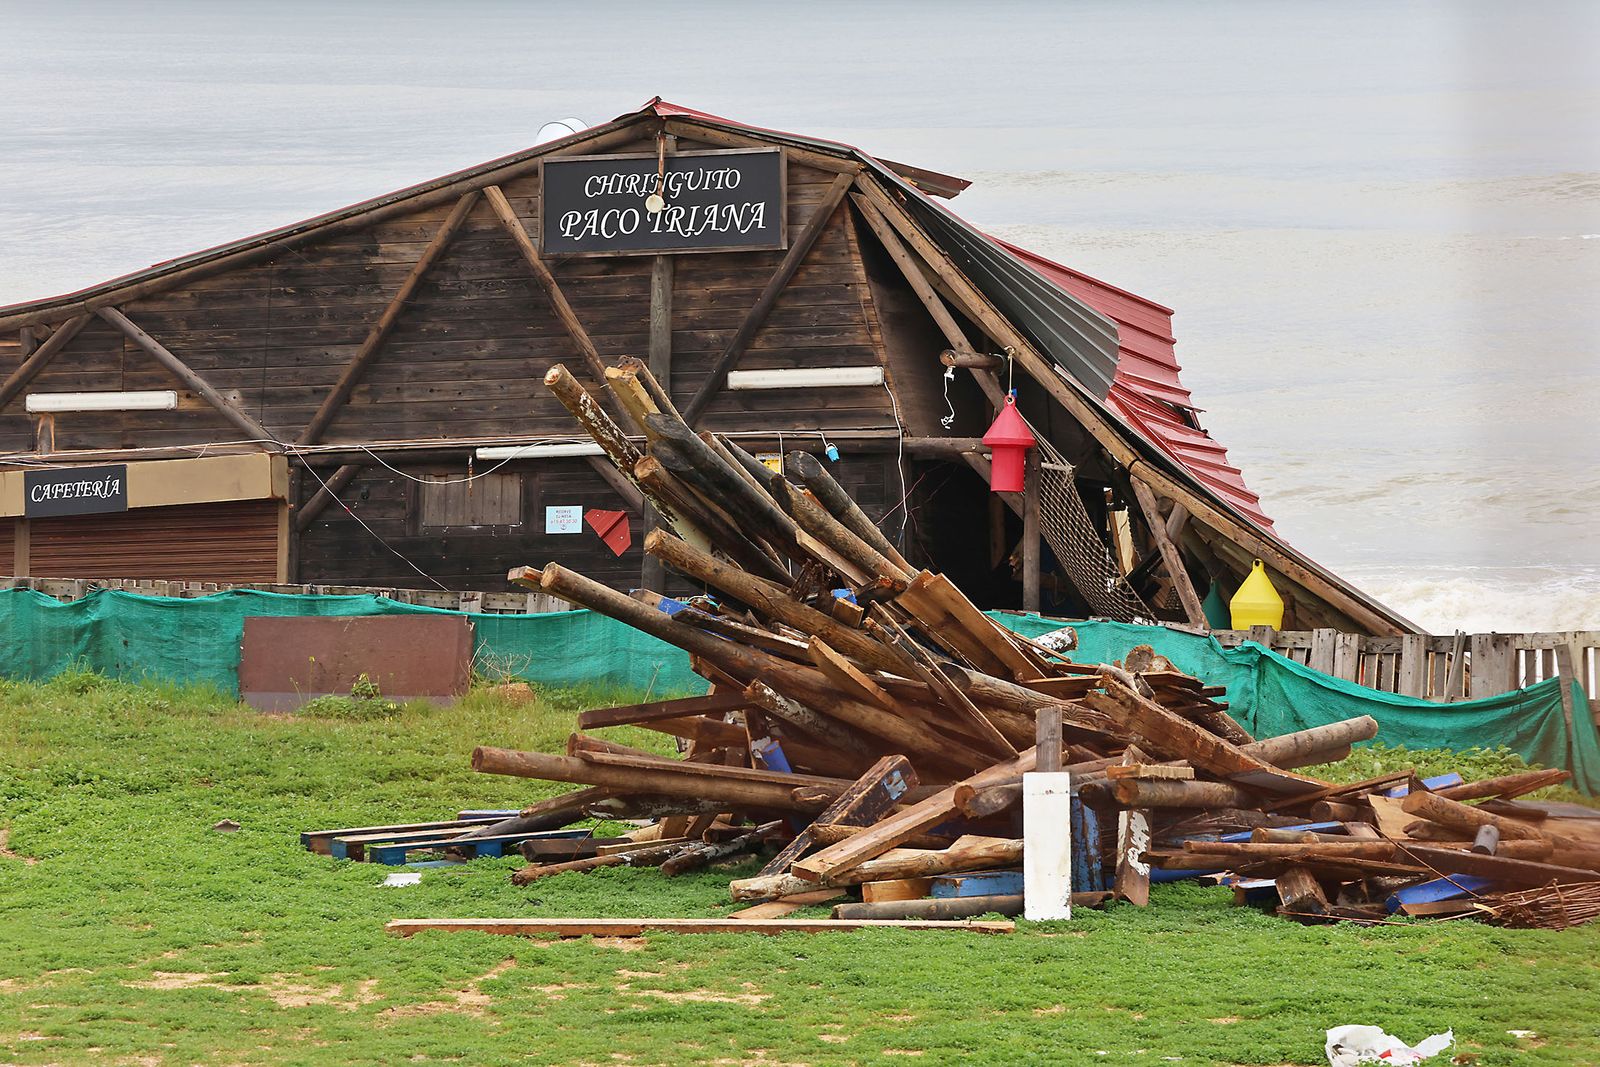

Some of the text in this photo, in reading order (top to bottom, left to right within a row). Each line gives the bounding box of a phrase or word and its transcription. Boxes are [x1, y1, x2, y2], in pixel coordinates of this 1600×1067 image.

[584, 167, 741, 199] CHIRINGUITO
[559, 201, 767, 241] PACO TRIANA
[31, 475, 121, 502] CAFETERÍA
